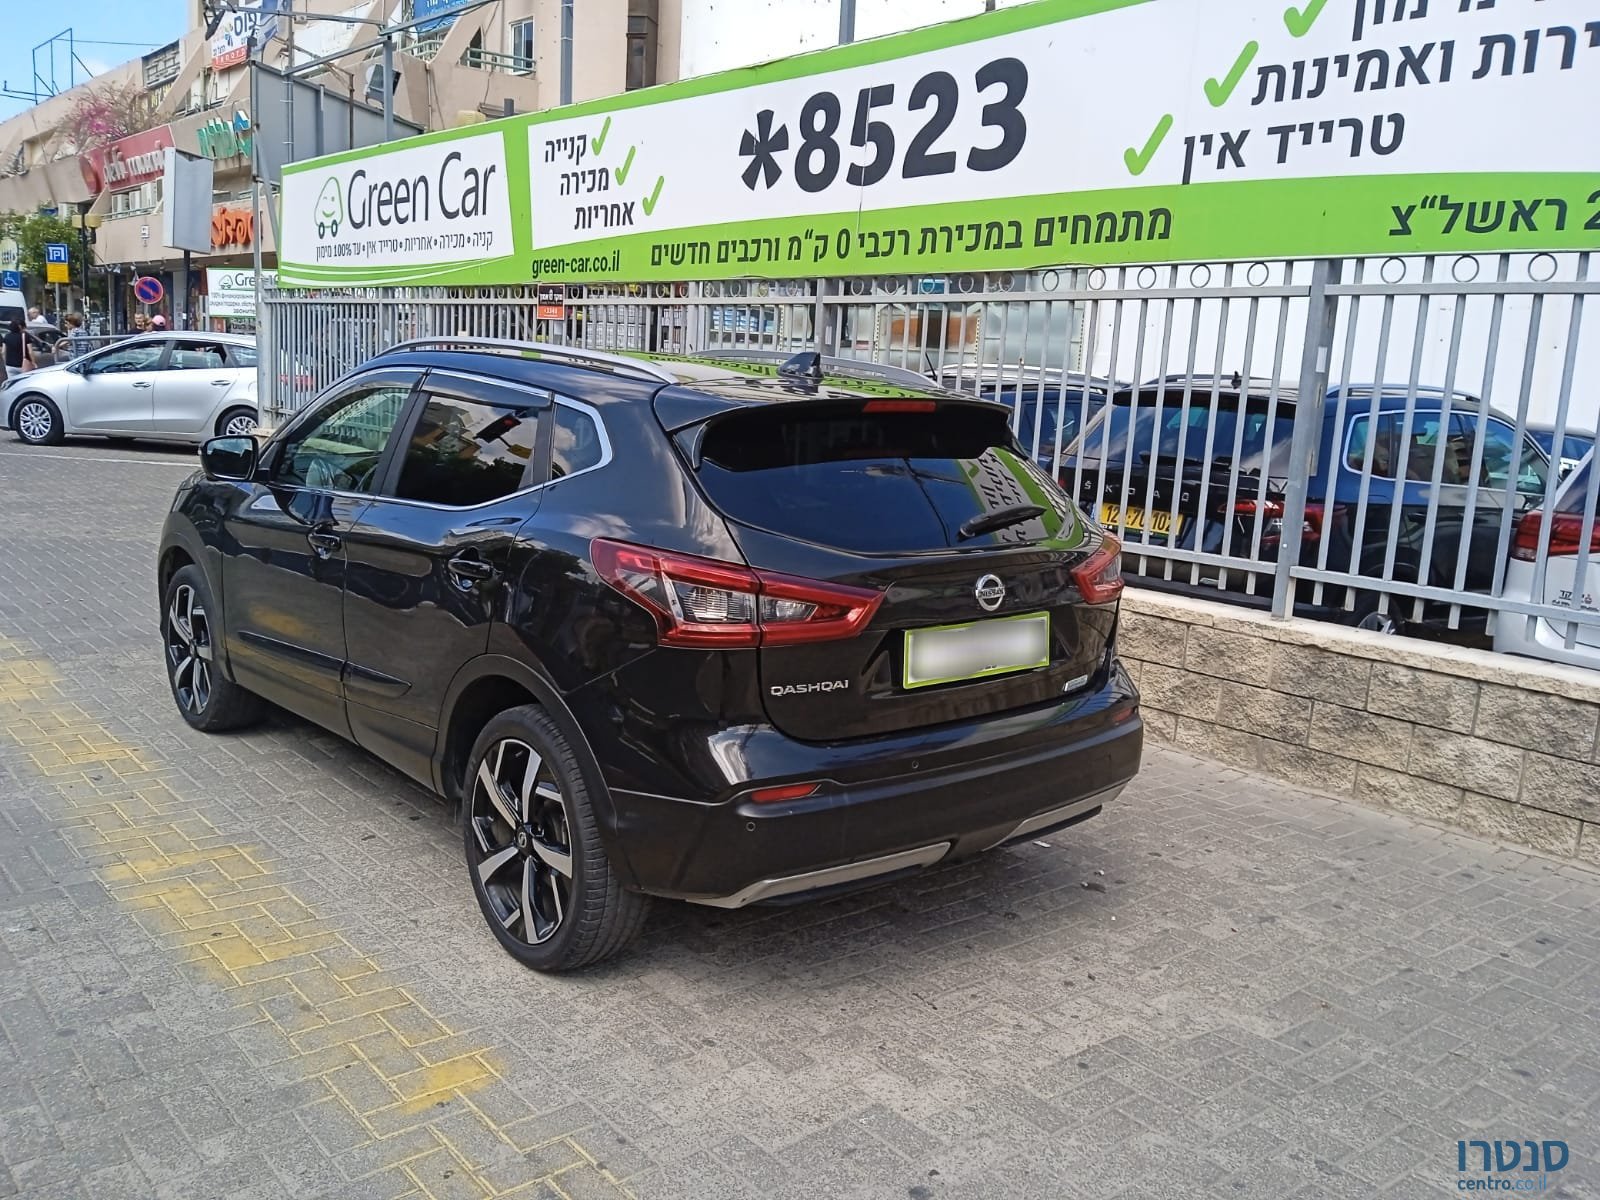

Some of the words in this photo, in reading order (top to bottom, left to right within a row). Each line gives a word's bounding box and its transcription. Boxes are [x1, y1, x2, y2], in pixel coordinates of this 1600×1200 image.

[1251, 39, 1455, 106] ואמינות
[545, 134, 587, 166] קנייה
[1267, 112, 1405, 164] טרייד
[1182, 128, 1251, 185] אין
[348, 169, 429, 229] Green
[439, 151, 496, 219] Car
[560, 167, 609, 196] מכירה
[574, 201, 635, 230] אחריות
[1034, 207, 1171, 247] מתמחים
[334, 243, 352, 257] 100%
[352, 242, 361, 256] עד
[366, 242, 376, 258] אין
[378, 239, 398, 253] טרייד
[404, 236, 432, 253] אחריות
[439, 233, 464, 250] מכירה
[472, 231, 493, 251] קניה
[717, 237, 779, 263] ורכבים
[837, 228, 850, 259] 0
[859, 230, 910, 258] רכבי
[920, 220, 1023, 254] במכירת
[316, 245, 331, 262] מימון
[532, 249, 620, 279] green-car.co.il
[651, 241, 710, 266] חדשים
[981, 587, 1003, 598] NISSAN
[770, 679, 849, 697] QASHQAI
